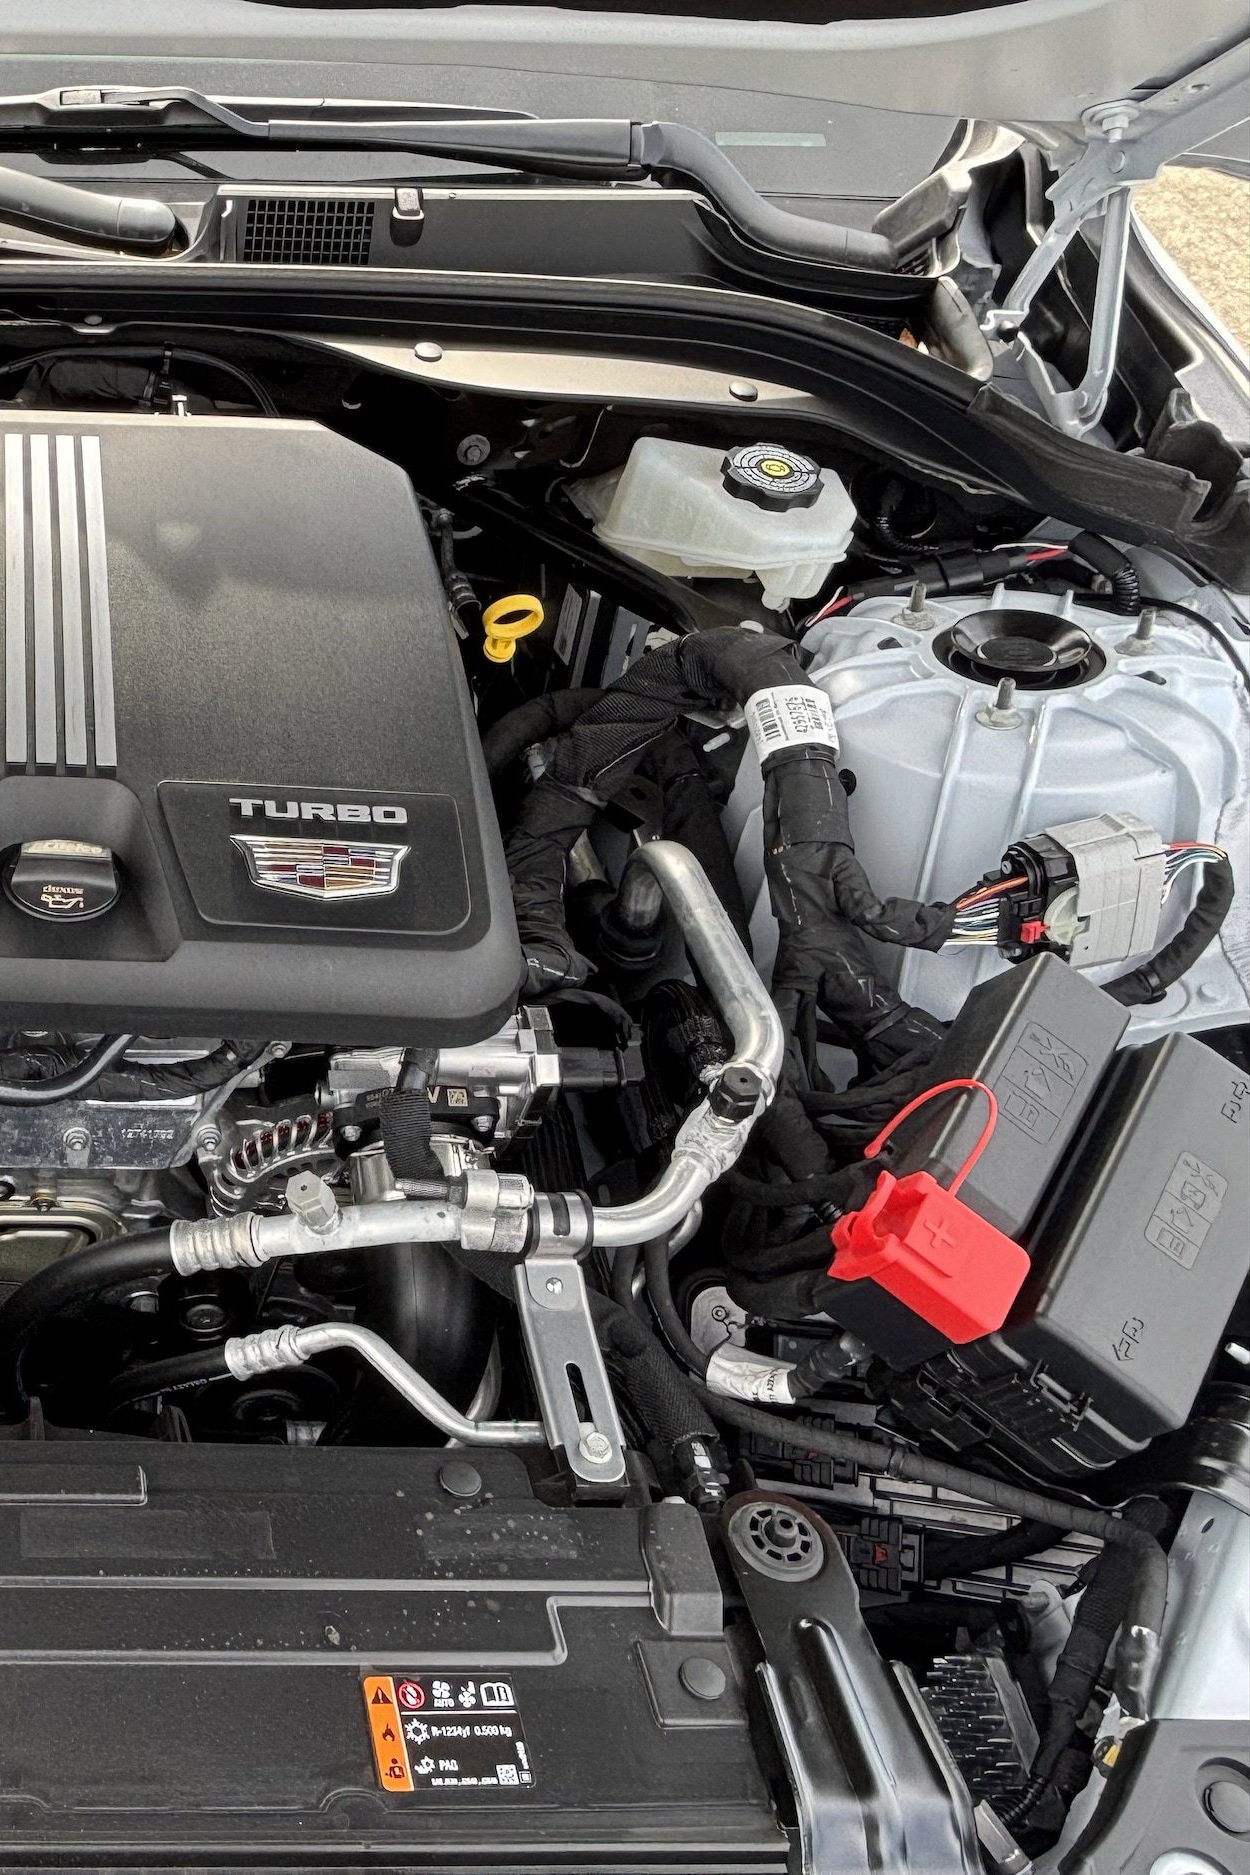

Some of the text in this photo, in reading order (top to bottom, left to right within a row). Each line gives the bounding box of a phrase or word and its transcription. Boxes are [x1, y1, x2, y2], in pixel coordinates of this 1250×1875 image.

[229, 798, 408, 823] TURBO
[433, 1699, 455, 1708] AUTO
[499, 1724, 512, 1737] kg
